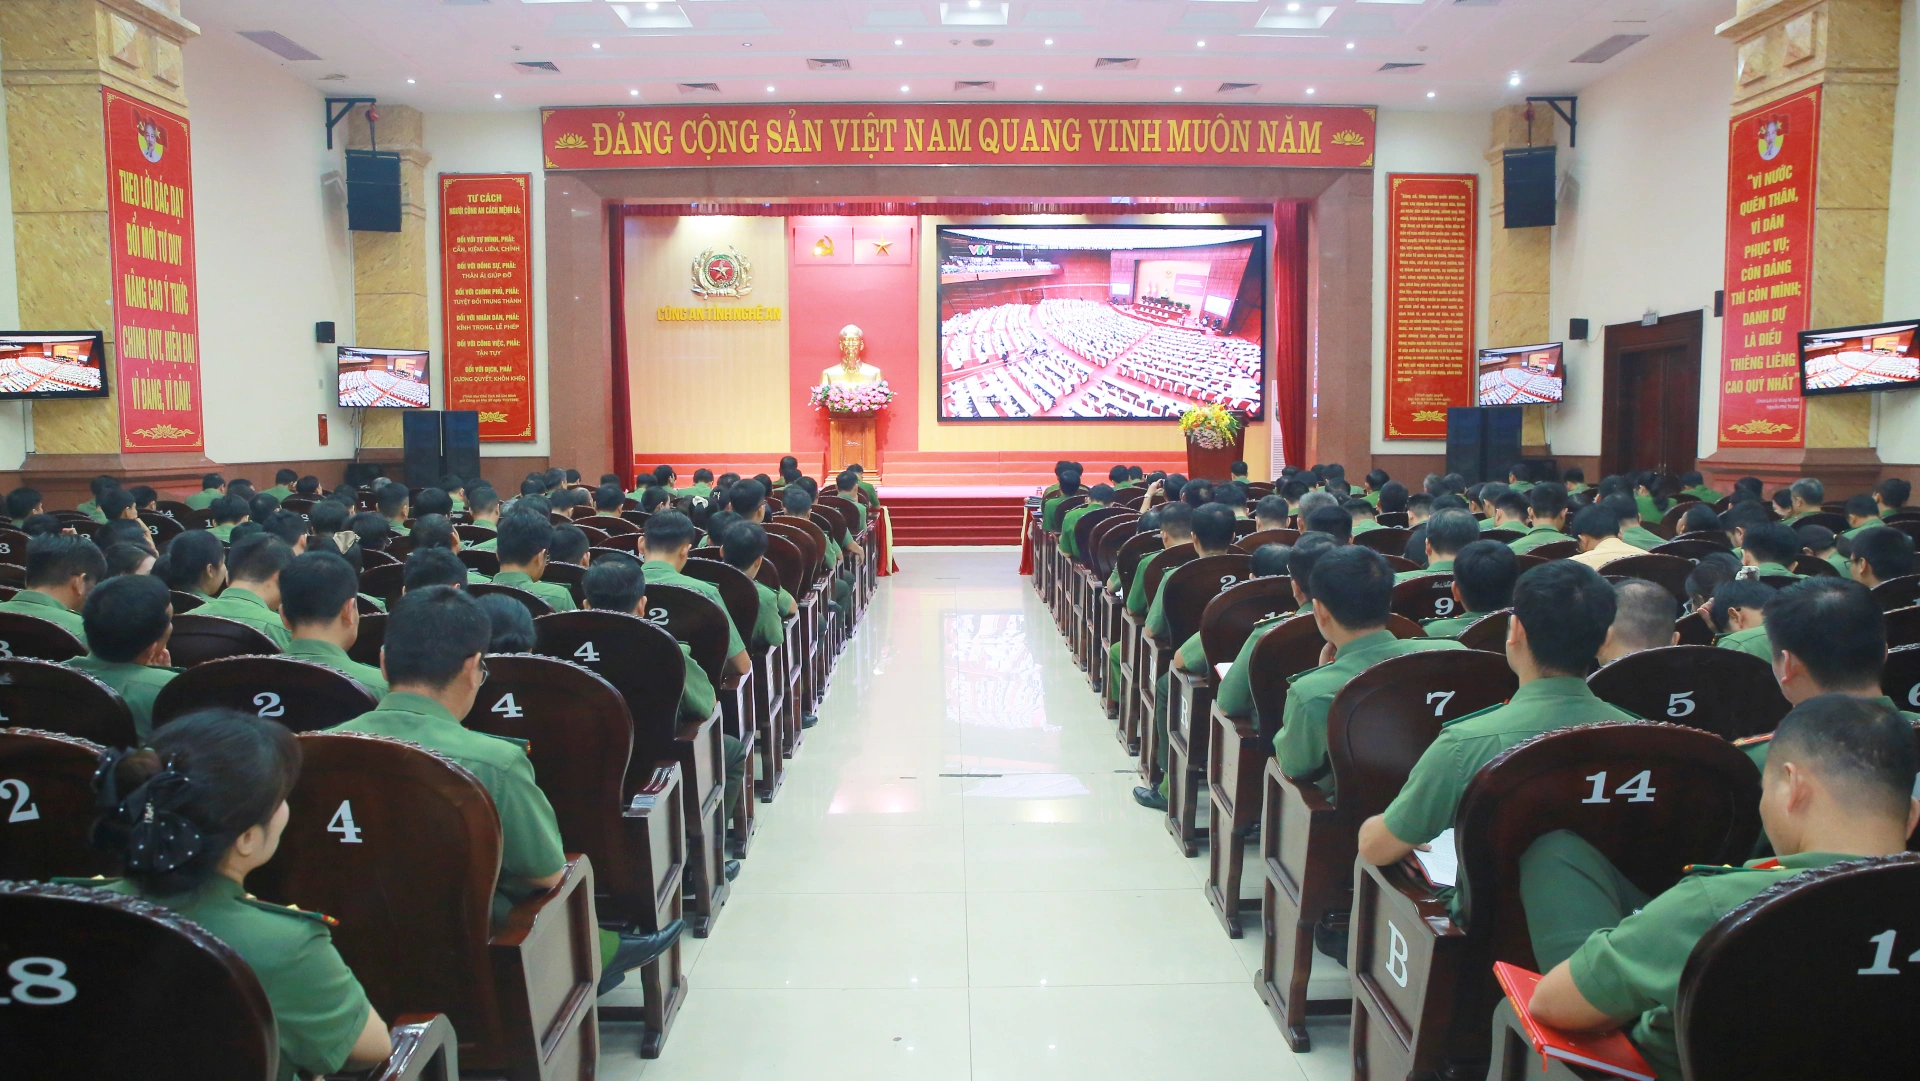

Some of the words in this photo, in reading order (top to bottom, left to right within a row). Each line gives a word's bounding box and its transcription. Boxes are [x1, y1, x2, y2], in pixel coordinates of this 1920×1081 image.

[593, 111, 673, 156] ĐẢNG
[680, 113, 759, 160] CỘNG
[766, 109, 822, 154] SẢN
[830, 112, 897, 159] VIỆT
[904, 118, 972, 152] NAM
[978, 118, 1082, 154] QUANG
[1088, 120, 1161, 153] VINH
[1166, 113, 1252, 154] MUÔN
[1256, 114, 1323, 154] NĂM
[1764, 164, 1792, 186] NƯỚC
[119, 169, 139, 206] THEO
[140, 169, 153, 210] LỜI
[154, 175, 169, 214] BÁC
[170, 186, 184, 224] DẠY
[468, 194, 478, 202] TƯ
[480, 193, 502, 202] CÁCH
[1740, 196, 1766, 216] QUÊN
[1769, 187, 1798, 208] THÂN,
[1751, 220, 1760, 235] VÌ
[1763, 214, 1784, 232] DÂN
[126, 211, 140, 257] ĐỔI
[142, 222, 156, 260] MỚI
[158, 229, 167, 263] TƯ
[168, 233, 182, 266] DUY
[1744, 241, 1771, 259] PHỤC
[1773, 236, 1790, 254] VỤ;
[1741, 263, 1760, 282] CÒN
[1764, 258, 1792, 276] ĐẢNG
[125, 268, 147, 309] NÂNG
[148, 278, 164, 311] CAO
[164, 275, 169, 312] Ý
[170, 277, 188, 315] THỨC
[1731, 287, 1745, 306] THÌ
[1748, 285, 1768, 303] CÒN
[1771, 281, 1802, 299] MÌNH;
[657, 304, 687, 321] CÔNG
[688, 307, 702, 321] AN
[704, 303, 733, 321] TỈNH
[733, 304, 763, 324] NGHỆ
[763, 307, 781, 321] AN
[1742, 310, 1769, 326] DANH
[1772, 306, 1788, 324] DỰ
[123, 320, 147, 359] CHÍNH
[148, 328, 164, 365] QUY,
[165, 325, 182, 369] HIỆN
[183, 333, 195, 370] ĐẠI
[1744, 335, 1756, 348] LÀ
[1759, 327, 1782, 345] ĐIỀU
[1730, 356, 1764, 372] THIÊNG
[1766, 351, 1796, 369] LIÊNG
[132, 371, 140, 410] VÌ
[141, 368, 164, 414] ĐẢNG,
[165, 373, 173, 410] VÌ
[174, 374, 192, 411] DÂN!
[1725, 380, 1743, 394] CAO
[1746, 376, 1764, 393] QUÝ
[649, 608, 670, 625] 2
[1434, 597, 1454, 615] 9
[574, 641, 600, 662] 4
[252, 692, 285, 718] 2
[490, 692, 524, 718] 4
[1426, 690, 1455, 716] 7
[1667, 690, 1696, 717] 5
[1581, 770, 1657, 804] 14
[0, 778, 40, 823] 2
[327, 800, 363, 843] 4
[1385, 920, 1408, 987] B
[1858, 929, 1920, 974] 1
[0, 957, 77, 1005] 8
